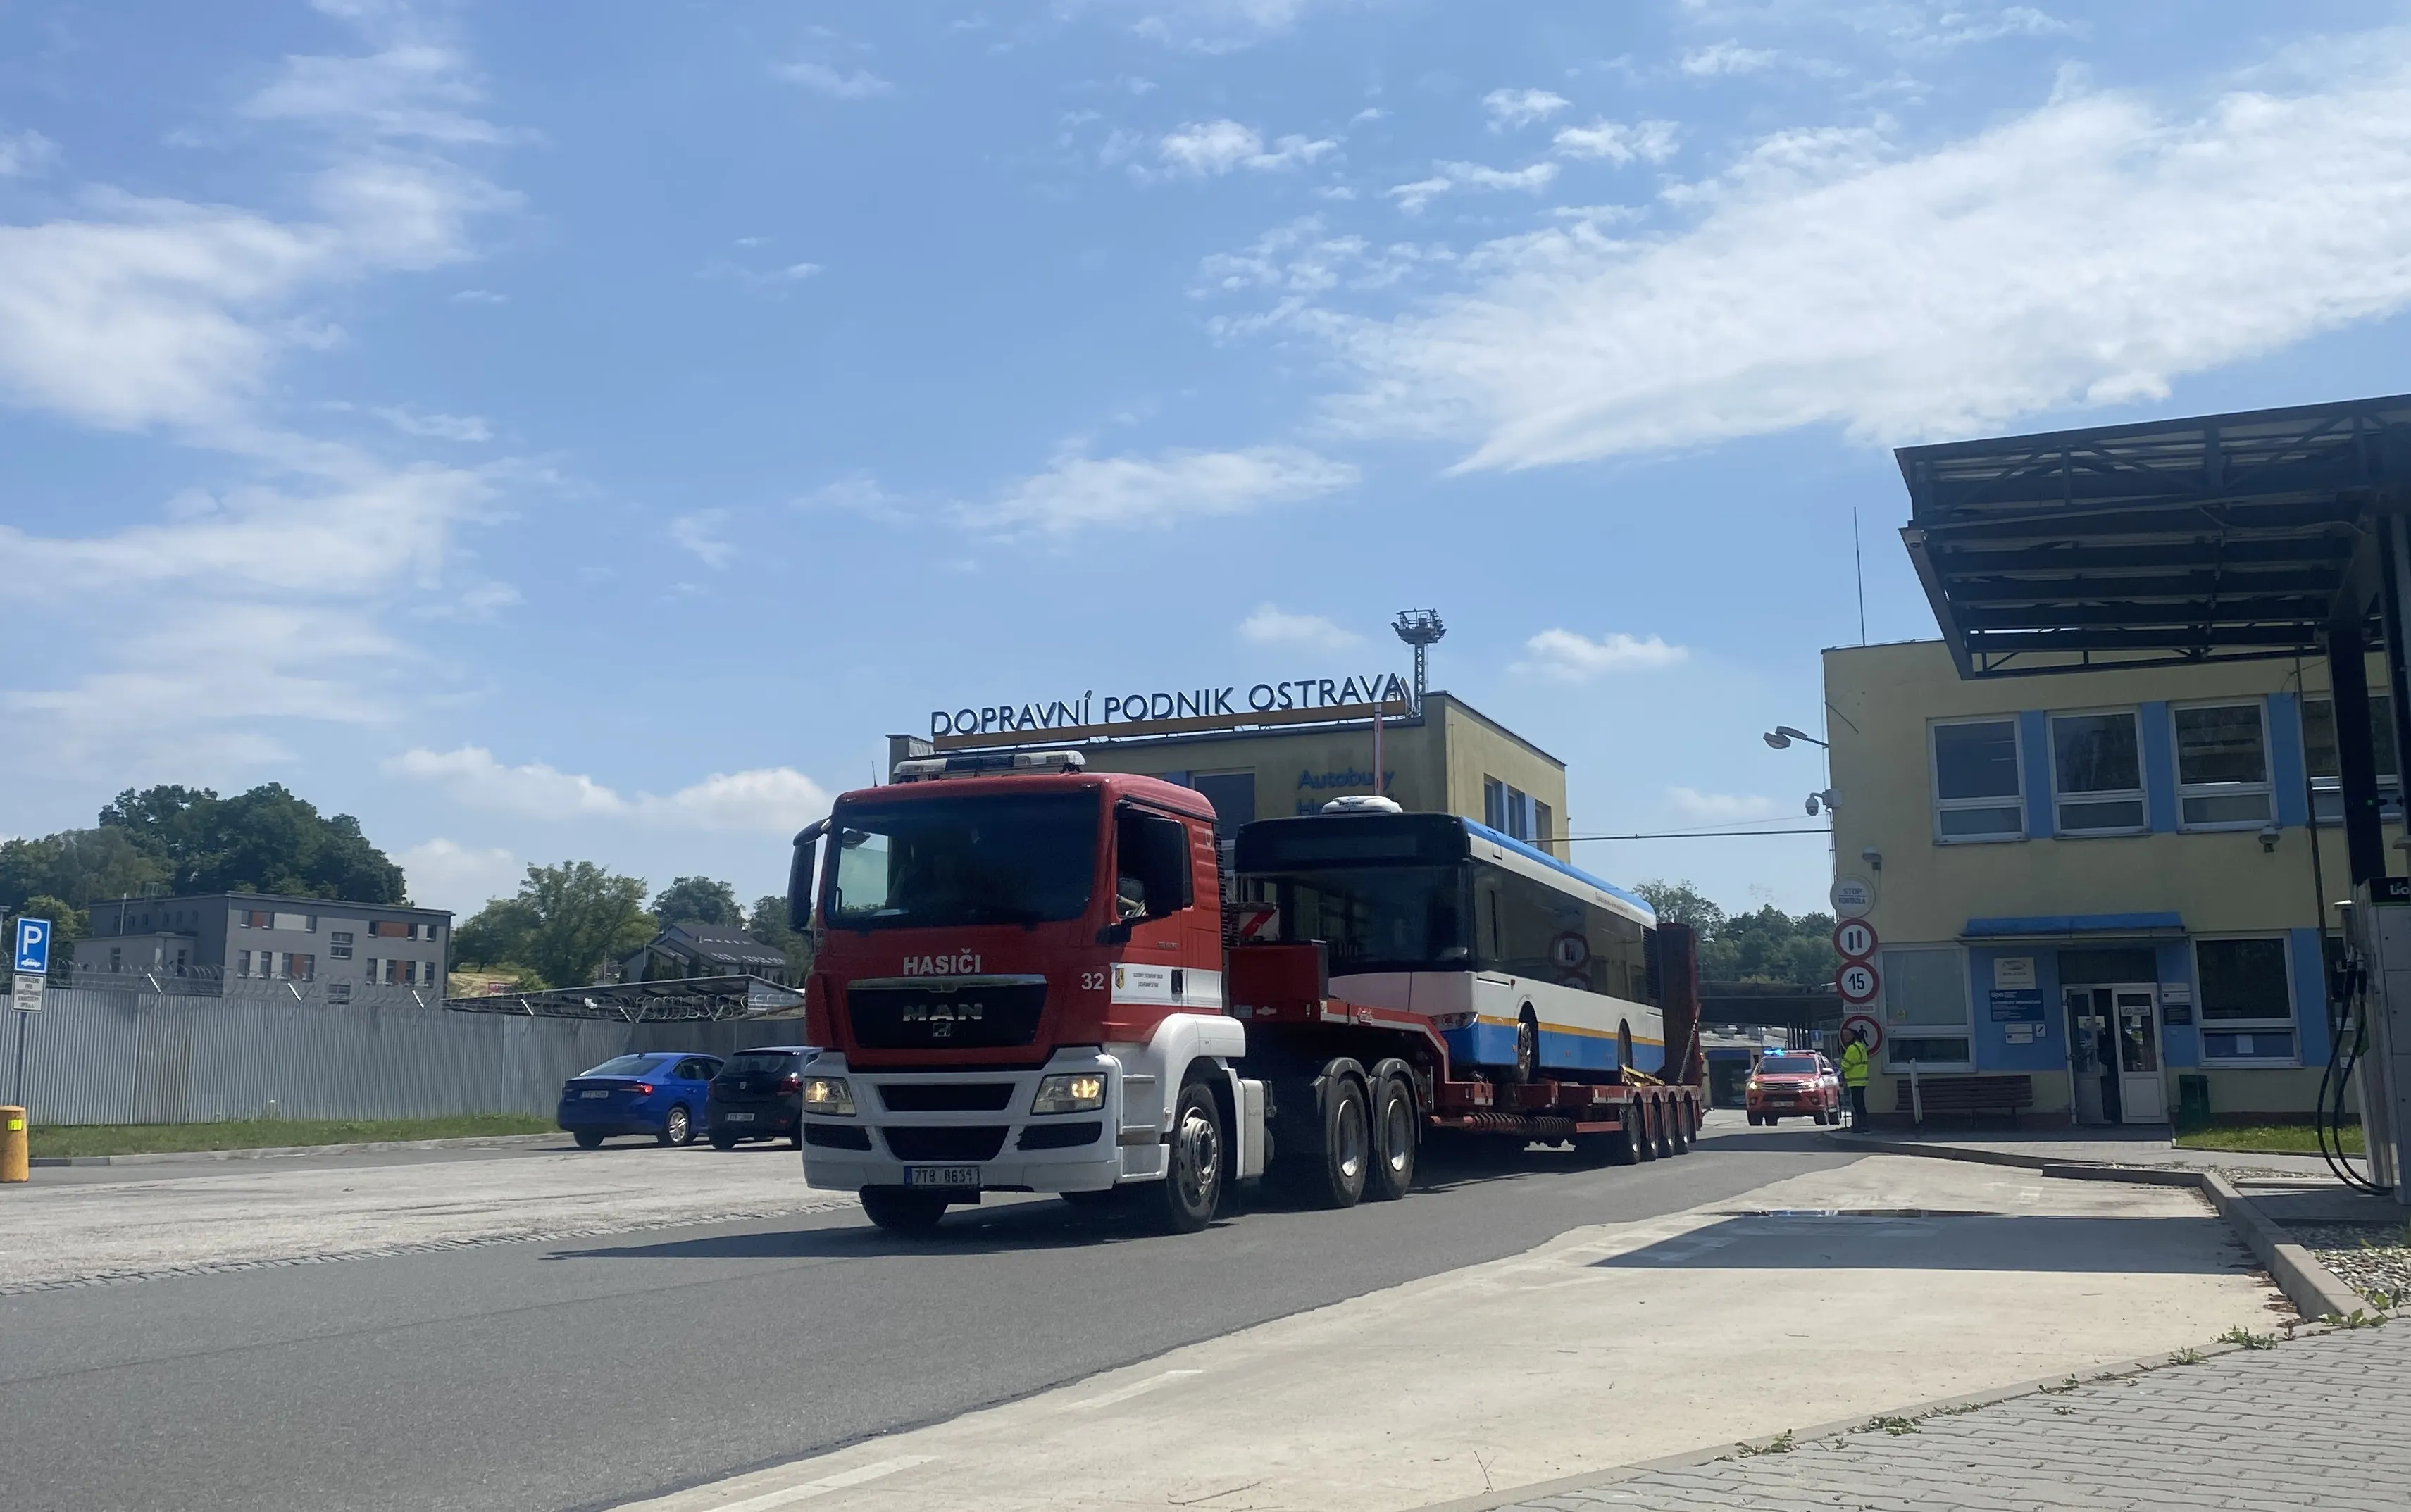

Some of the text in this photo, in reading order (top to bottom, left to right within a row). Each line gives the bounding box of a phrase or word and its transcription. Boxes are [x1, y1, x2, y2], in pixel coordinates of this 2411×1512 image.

[930, 672, 1407, 737] DOPRAVNÍ PODNIK OSTRAVA
[1296, 766, 1395, 792] Autobuy
[23, 925, 42, 956] P
[903, 947, 981, 975] HASIČI
[1080, 973, 1104, 990] 32
[1848, 973, 1865, 991] 15
[902, 1002, 983, 1022] MAN
